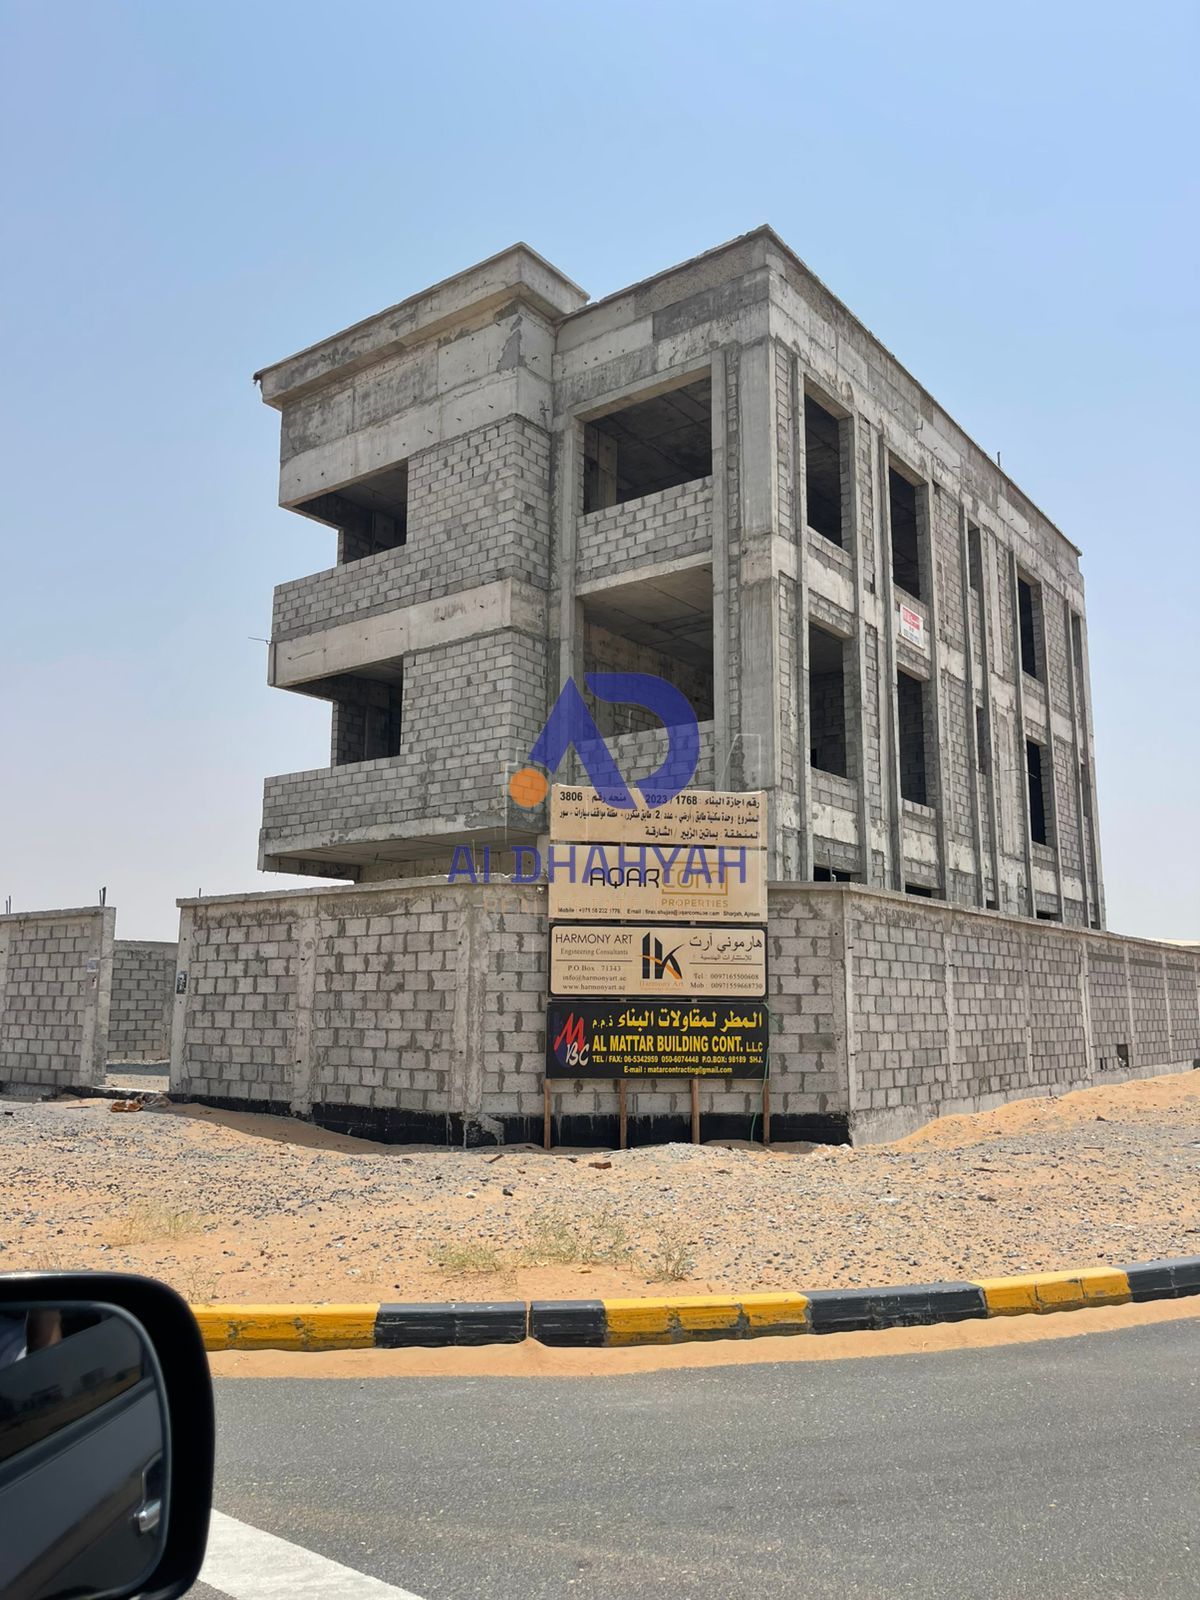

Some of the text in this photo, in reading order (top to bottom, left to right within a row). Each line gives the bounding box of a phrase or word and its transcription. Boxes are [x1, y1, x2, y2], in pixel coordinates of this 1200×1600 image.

[560, 791, 583, 801] 3806
[645, 794, 668, 804] 2023
[676, 796, 698, 805] 1768
[655, 810, 660, 820] 2
[661, 899, 728, 908] PROPERTIES
[555, 933, 633, 945] HARMONY ART
[716, 936, 763, 952] هارموني
[617, 1008, 654, 1032] البناء
[658, 1008, 718, 1032] لمقاولات
[720, 1010, 762, 1033] المطر
[592, 1035, 607, 1052] AL
[609, 1035, 655, 1052] MATTAR
[657, 1035, 709, 1053] BUILDING
[711, 1035, 744, 1053] CONT.
[592, 1055, 605, 1063] TEL
